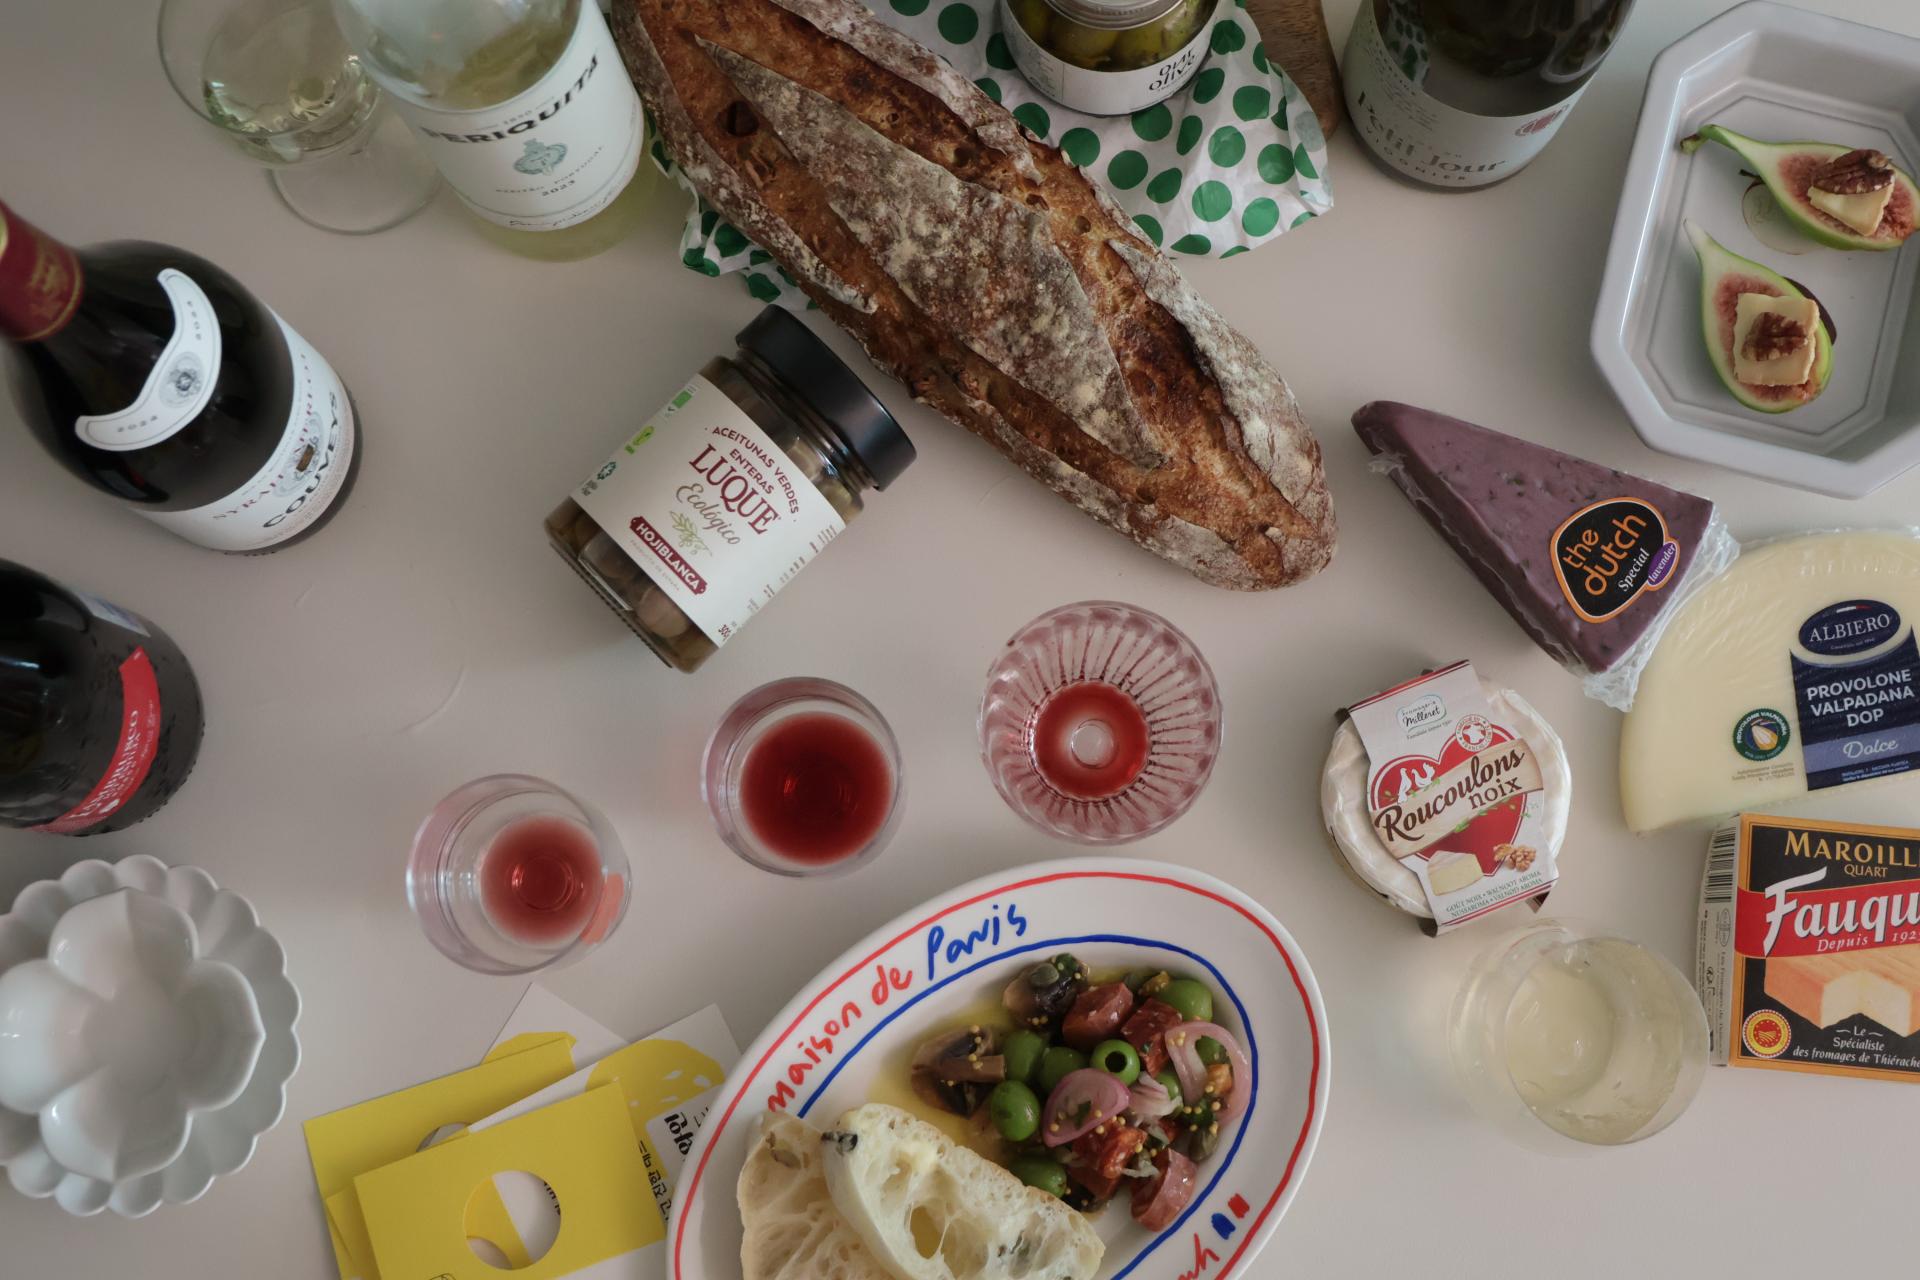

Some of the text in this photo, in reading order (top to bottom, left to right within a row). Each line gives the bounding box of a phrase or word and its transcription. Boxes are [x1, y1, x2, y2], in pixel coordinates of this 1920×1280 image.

[262, 391, 338, 528] COUVEYS
[712, 426, 799, 514] ACEITUNAS VERDES
[729, 448, 774, 495] ENTERAS
[689, 443, 779, 535] LUQUE
[676, 483, 741, 545] Ecológico
[635, 523, 700, 590] HOJIBLANCA
[1562, 529, 1599, 569] the
[1582, 514, 1647, 596] dutch
[1648, 544, 1676, 583] lavender
[1617, 547, 1650, 592] Special
[1809, 613, 1890, 642] ALBIERO
[1806, 669, 1912, 701] PROVOLONE
[1810, 685, 1915, 717] VALPADANA
[1402, 705, 1440, 727] Milleret
[1846, 708, 1884, 728] DOP
[1842, 739, 1899, 759] Dolce
[1374, 749, 1525, 842] Roucoulons
[1468, 776, 1522, 810] noix
[1784, 830, 1920, 868] MAROILL
[1843, 864, 1889, 878] QUART
[1763, 866, 1920, 957] Fauqu
[1817, 930, 1920, 952] Depuis 192
[767, 903, 1027, 1113] maison de Paris
[1832, 1036, 1885, 1051] Spécialiste
[1853, 1025, 1867, 1036] Le
[1793, 1045, 1809, 1057] des
[1811, 1047, 1856, 1063] fromages
[1858, 1052, 1871, 1063] de
